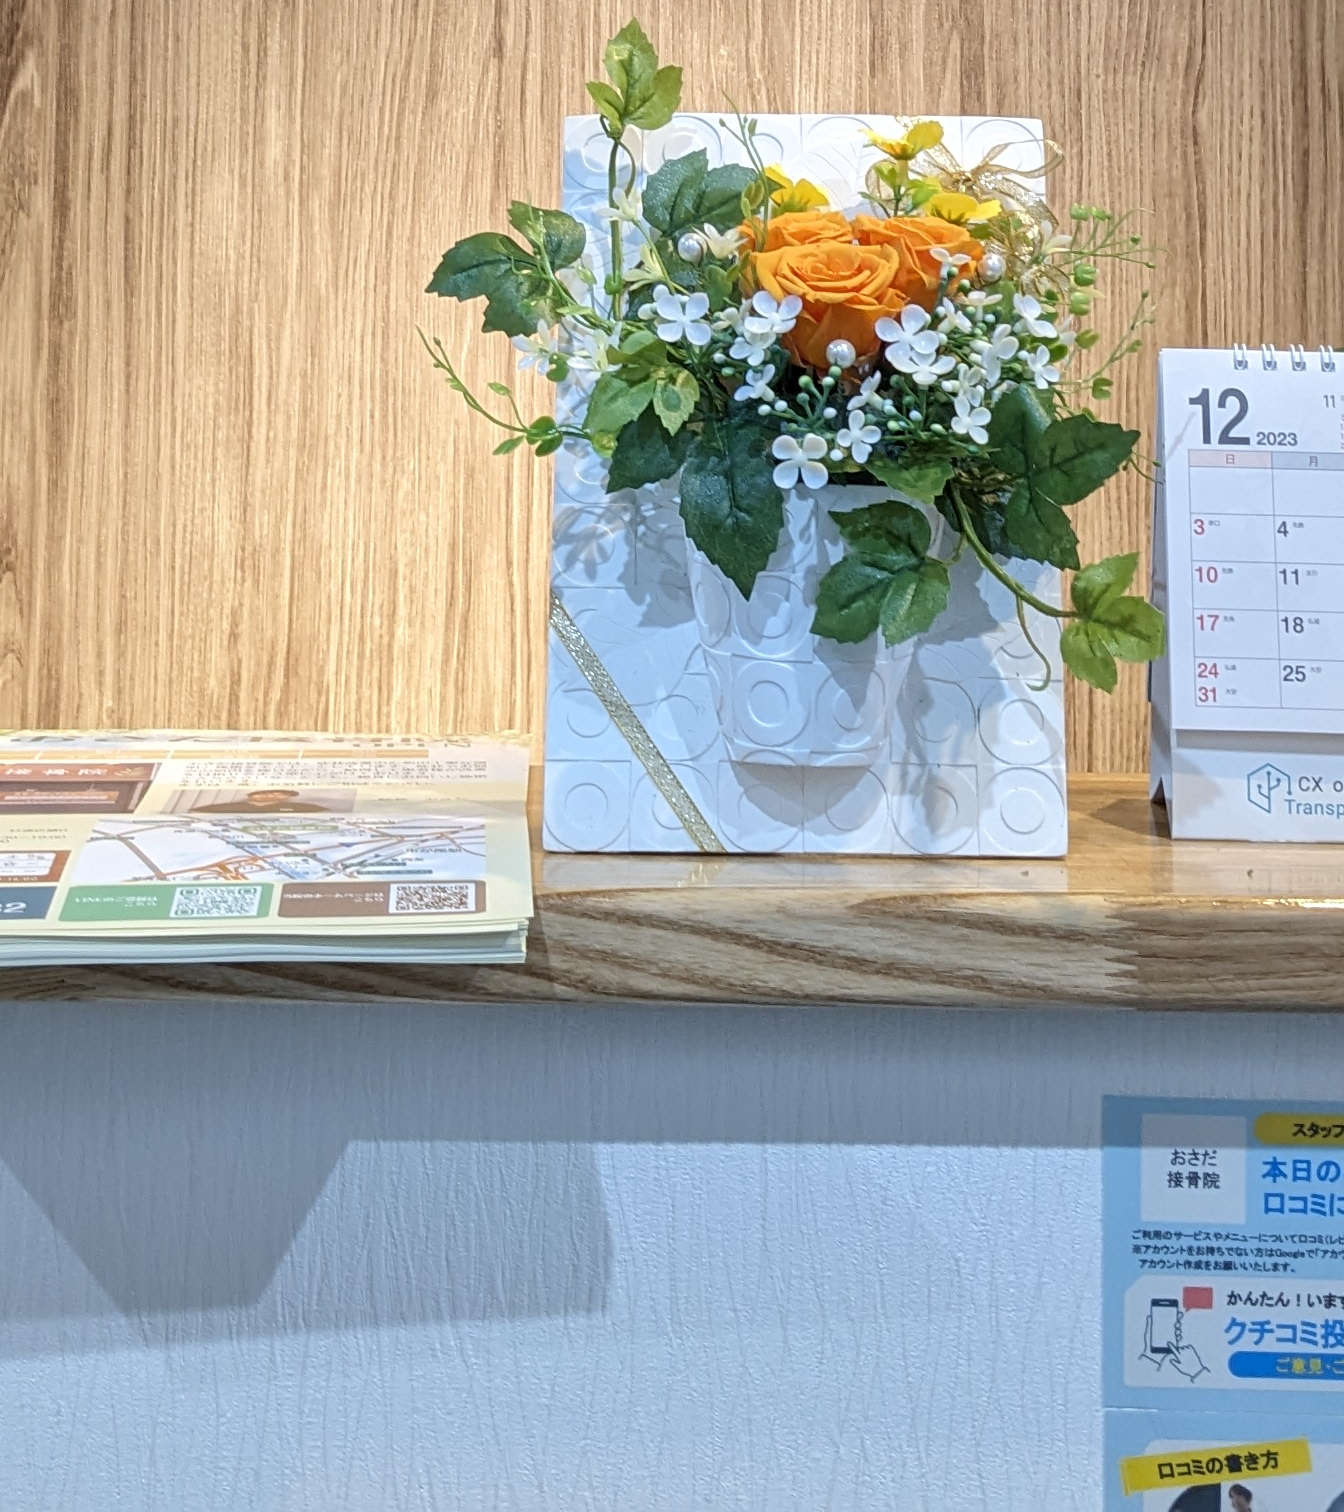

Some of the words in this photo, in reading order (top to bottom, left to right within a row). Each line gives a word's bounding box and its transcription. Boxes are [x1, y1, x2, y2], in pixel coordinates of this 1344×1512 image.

[1323, 395, 1336, 408] 11
[1188, 387, 1251, 446] 12
[1256, 432, 1299, 447] 2023
[1225, 455, 1235, 464] 日
[1308, 456, 1318, 466] 月
[1193, 519, 1205, 536] 3
[1276, 521, 1289, 538] 4
[1195, 567, 1218, 584] 10
[1279, 568, 1300, 585] 11
[1196, 614, 1220, 631] 17
[1280, 617, 1305, 634] 18
[1196, 662, 1220, 679] 24
[1282, 665, 1307, 682] 25
[1198, 686, 1218, 703] 31
[1298, 776, 1323, 793] CX
[1171, 1149, 1217, 1168] おさだ
[1167, 1171, 1221, 1190] 接骨院
[1157, 1448, 1280, 1480] 口コミの書き方
